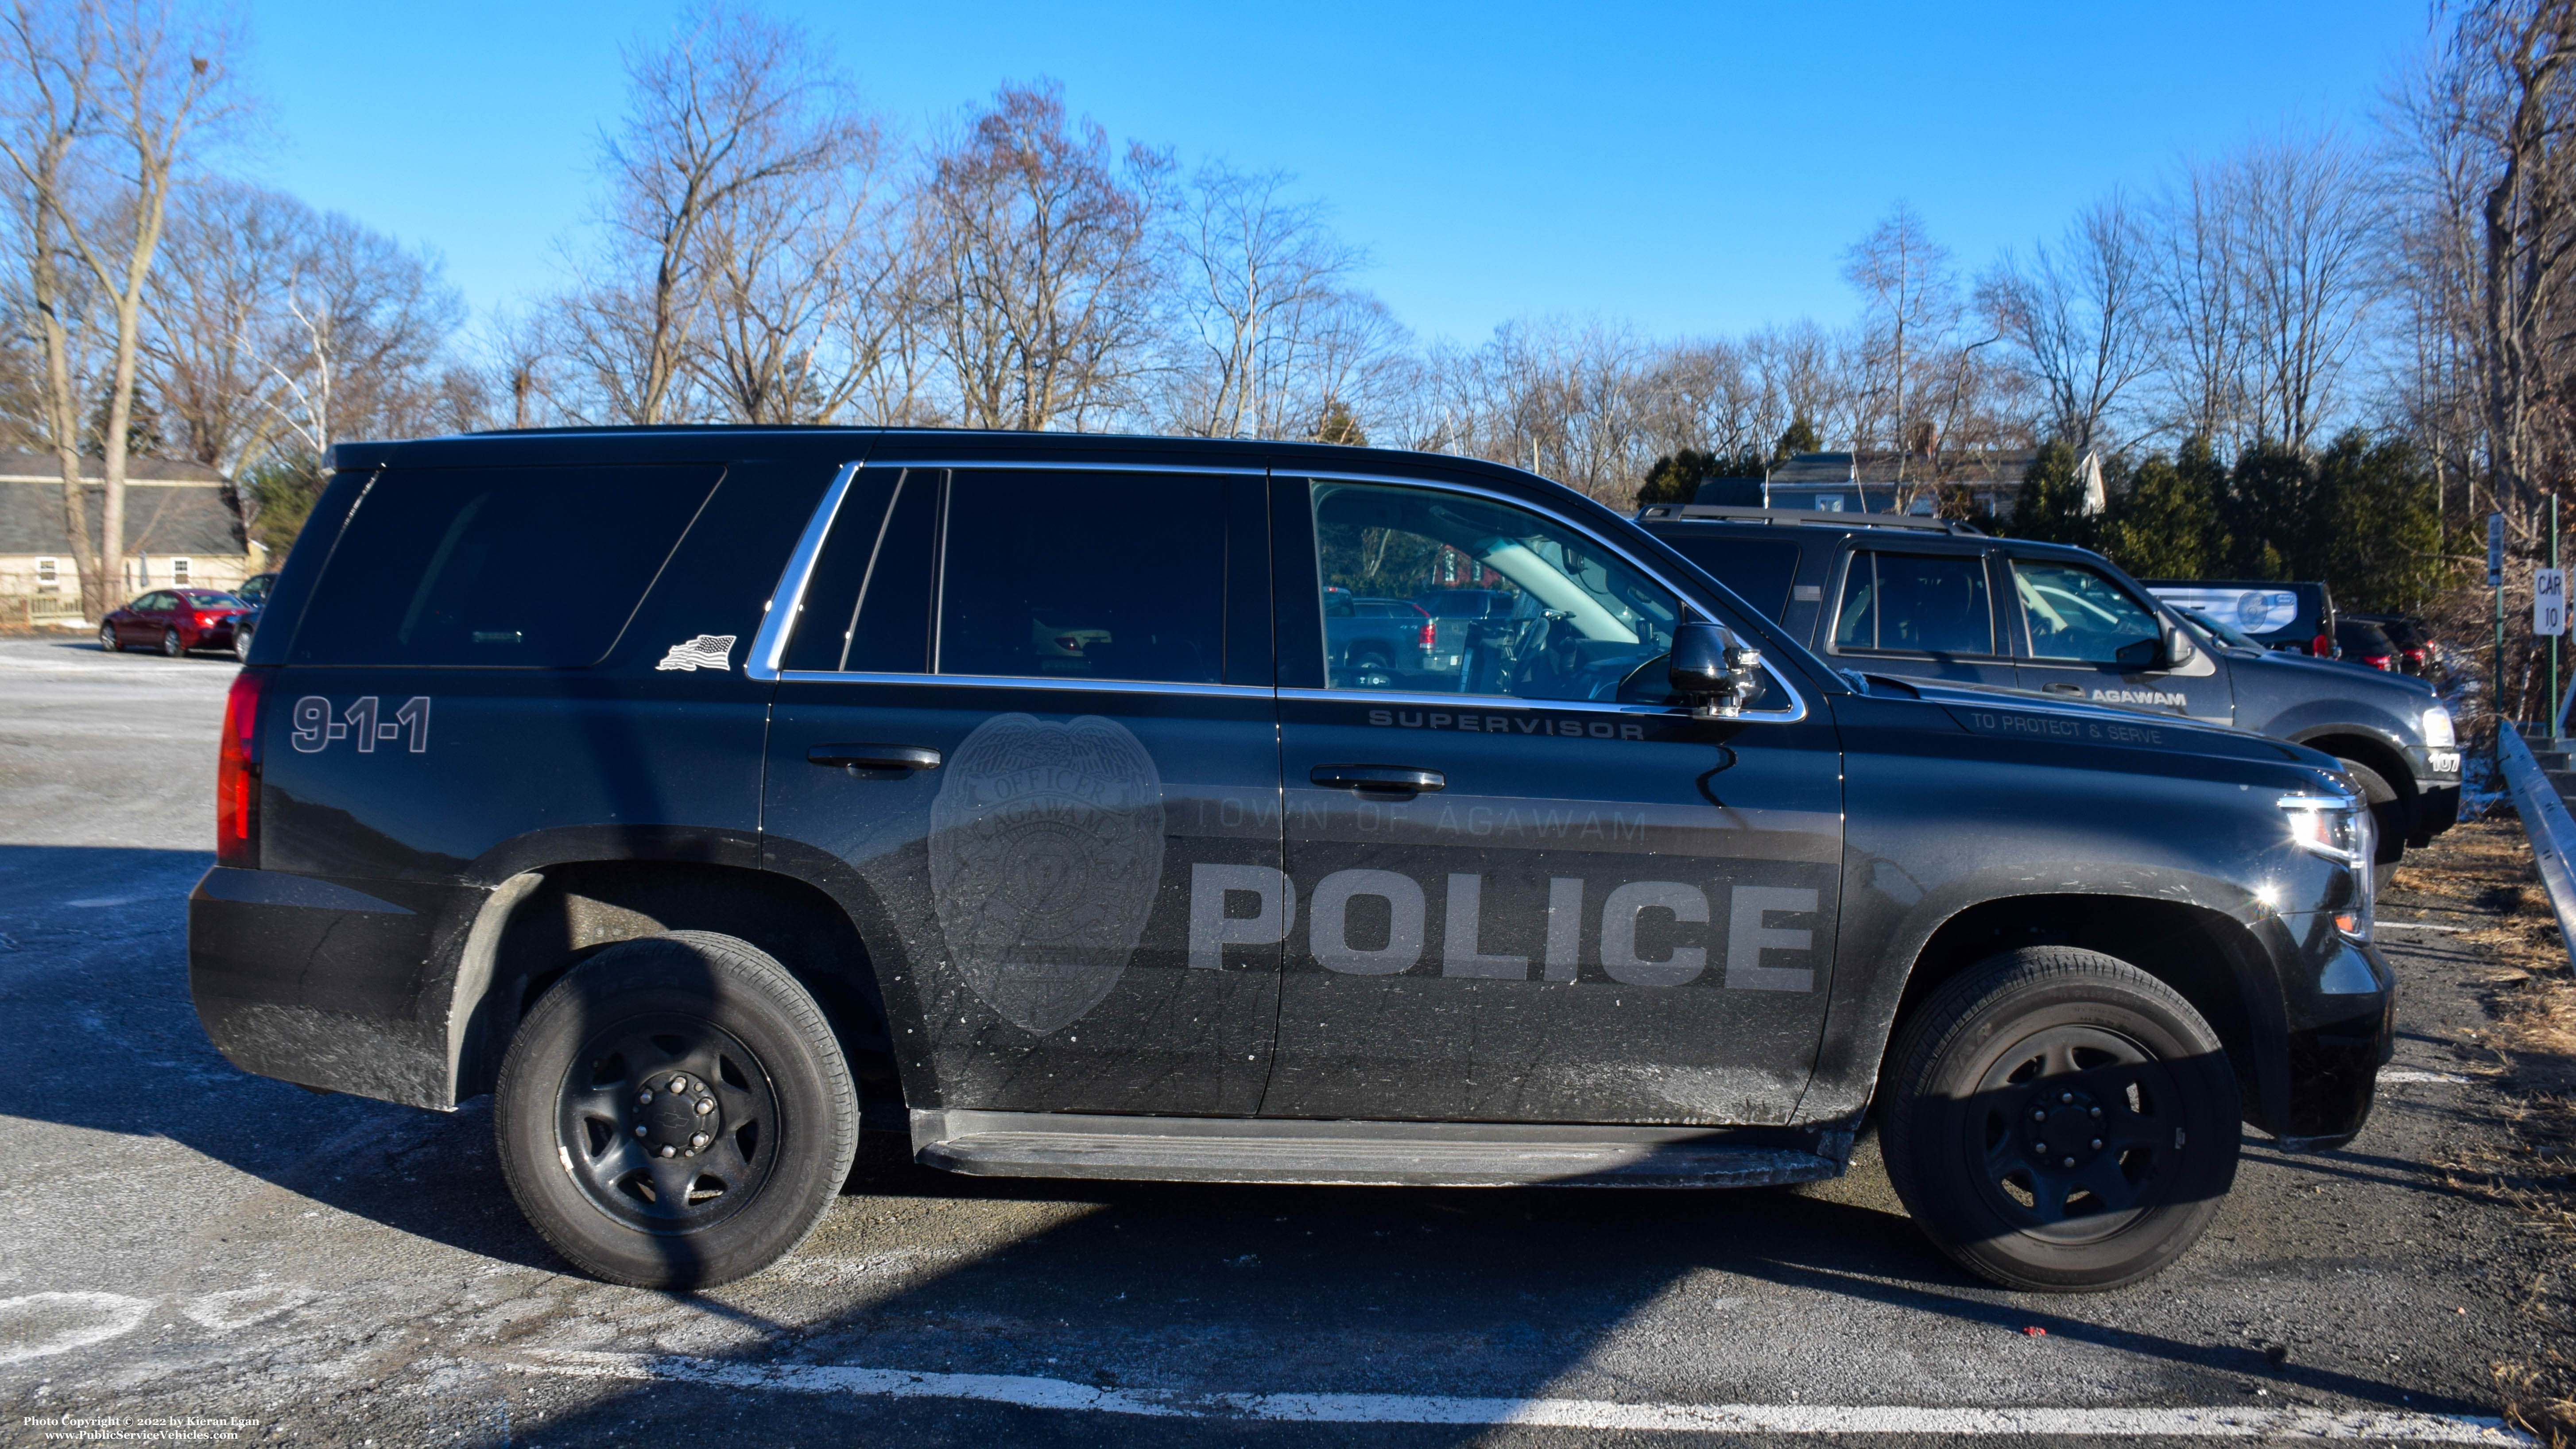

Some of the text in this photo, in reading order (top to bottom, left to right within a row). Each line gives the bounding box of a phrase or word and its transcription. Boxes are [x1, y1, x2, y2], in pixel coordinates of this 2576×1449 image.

[2538, 575, 2561, 596] CAR
[2545, 607, 2558, 627] 10
[2092, 689, 2187, 706] AGAWAM
[292, 696, 430, 753] 9-1-1
[1369, 709, 1644, 740] SUPERVISOR
[1971, 713, 2162, 744] TO PROTECT & SERVE
[2428, 752, 2460, 772] 107
[995, 767, 1106, 805] OFFICER
[994, 798, 1107, 832] AGAWAM
[1193, 798, 1646, 841] TOWN OF AGAWAM
[1187, 862, 1819, 992] POLICE
